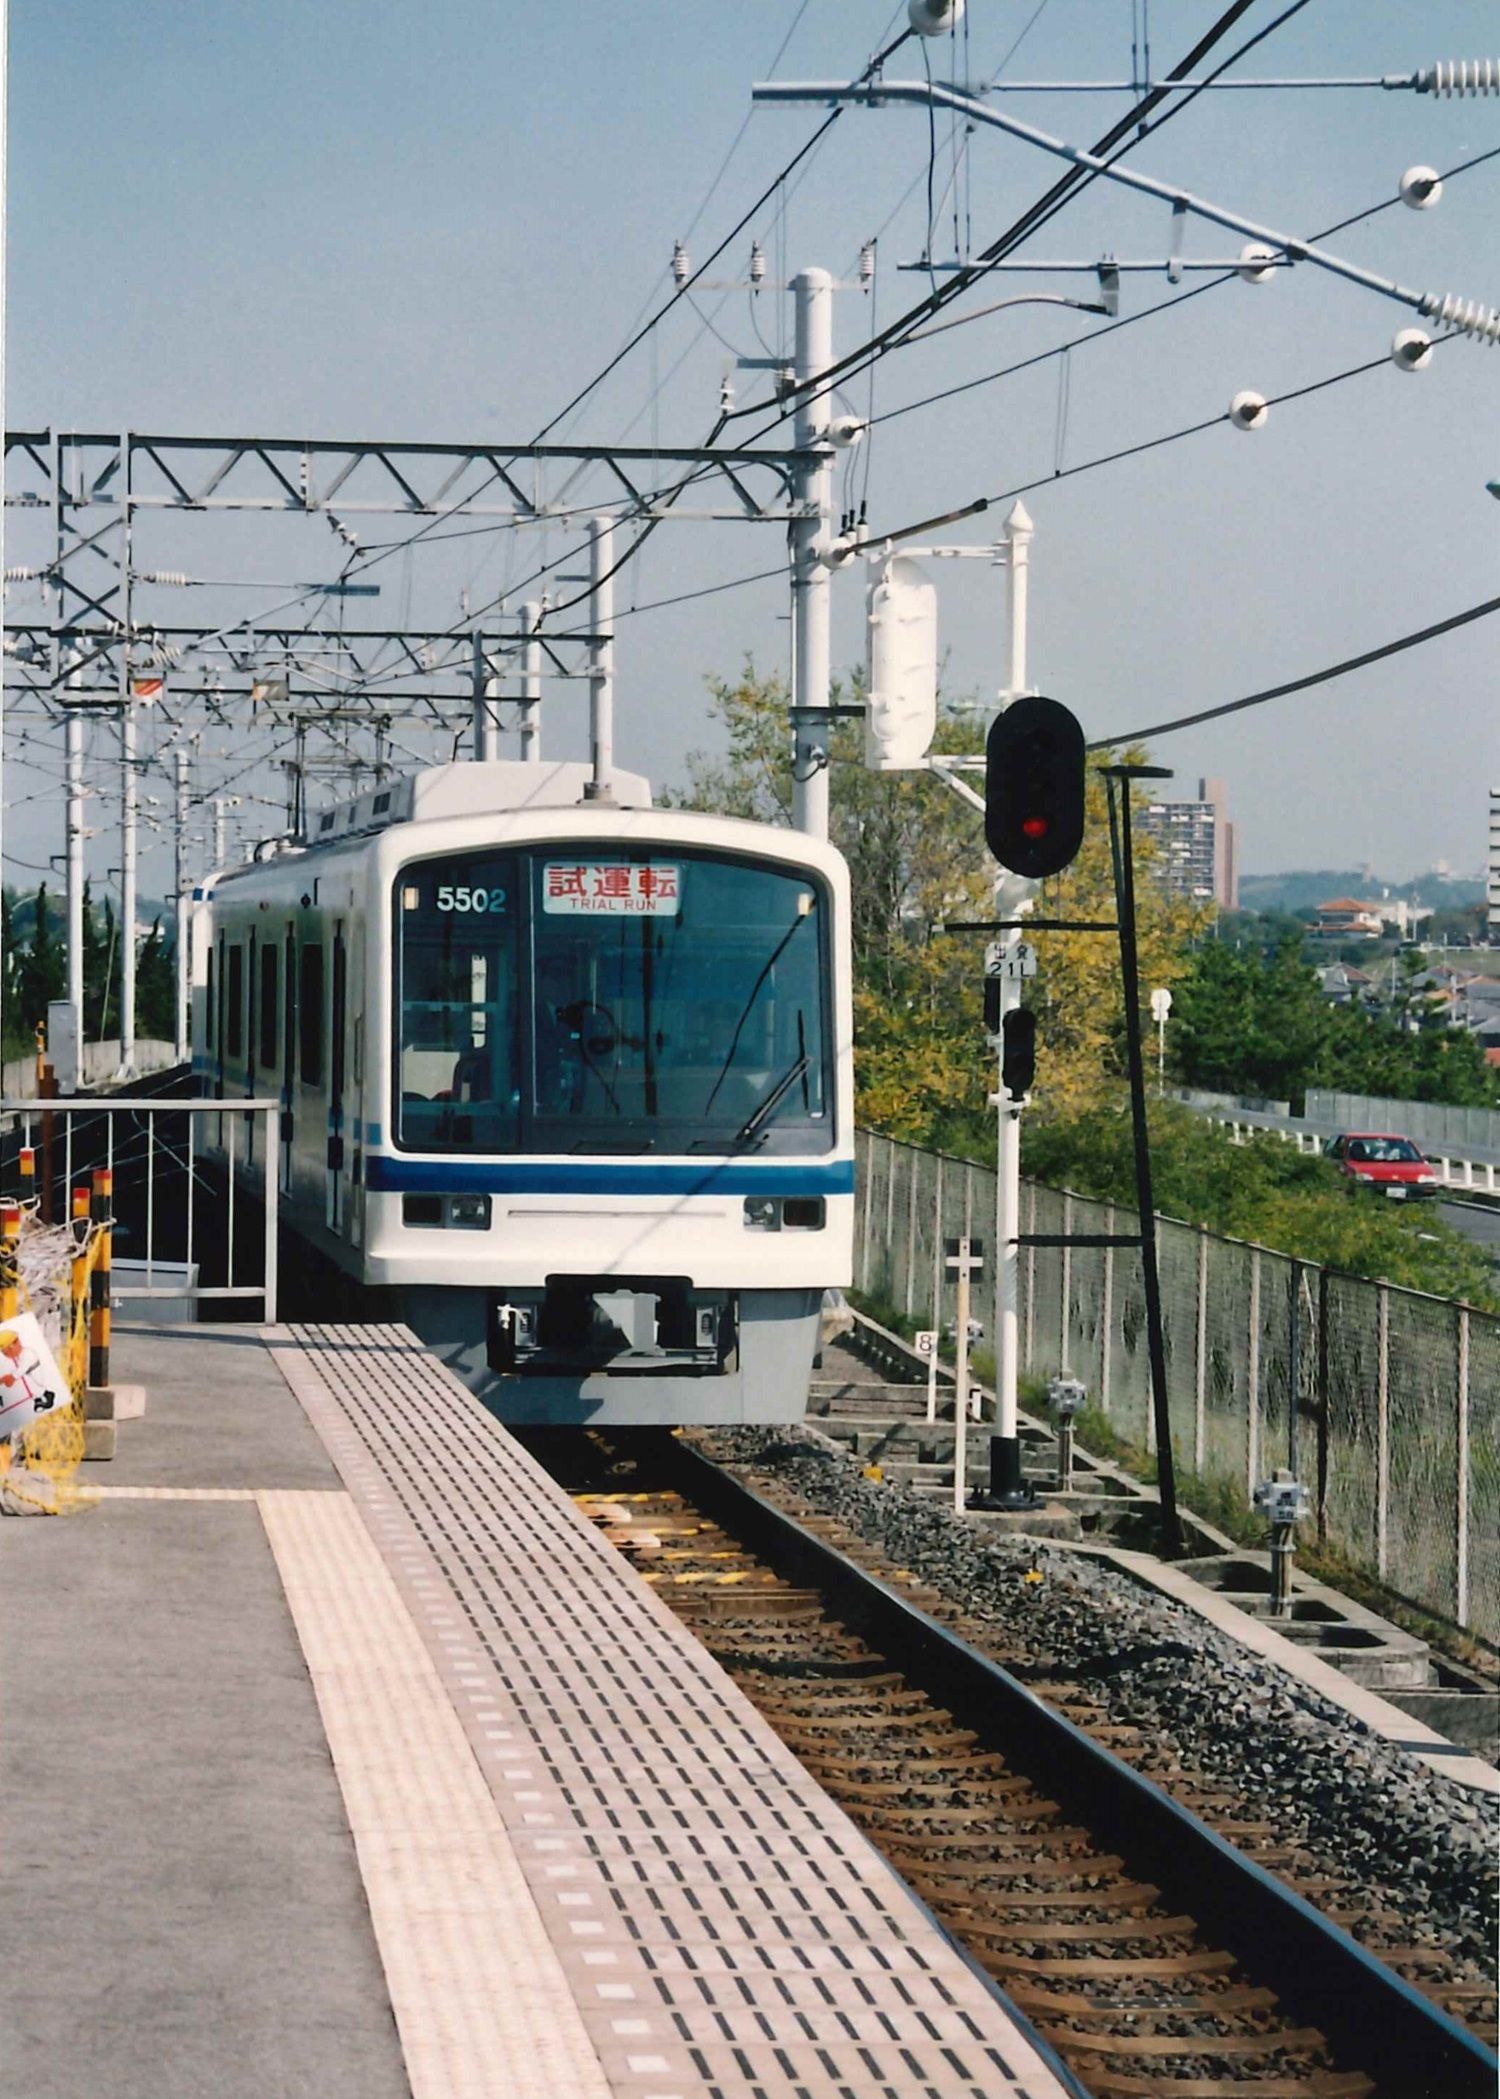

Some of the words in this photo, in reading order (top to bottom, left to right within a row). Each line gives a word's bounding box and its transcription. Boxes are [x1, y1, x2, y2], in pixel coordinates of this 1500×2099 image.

[548, 866, 677, 898] 試運転
[436, 886, 506, 913] 5502
[570, 898, 617, 911] TRIAL
[624, 898, 657, 911] RUN
[919, 1333, 932, 1352] 8
